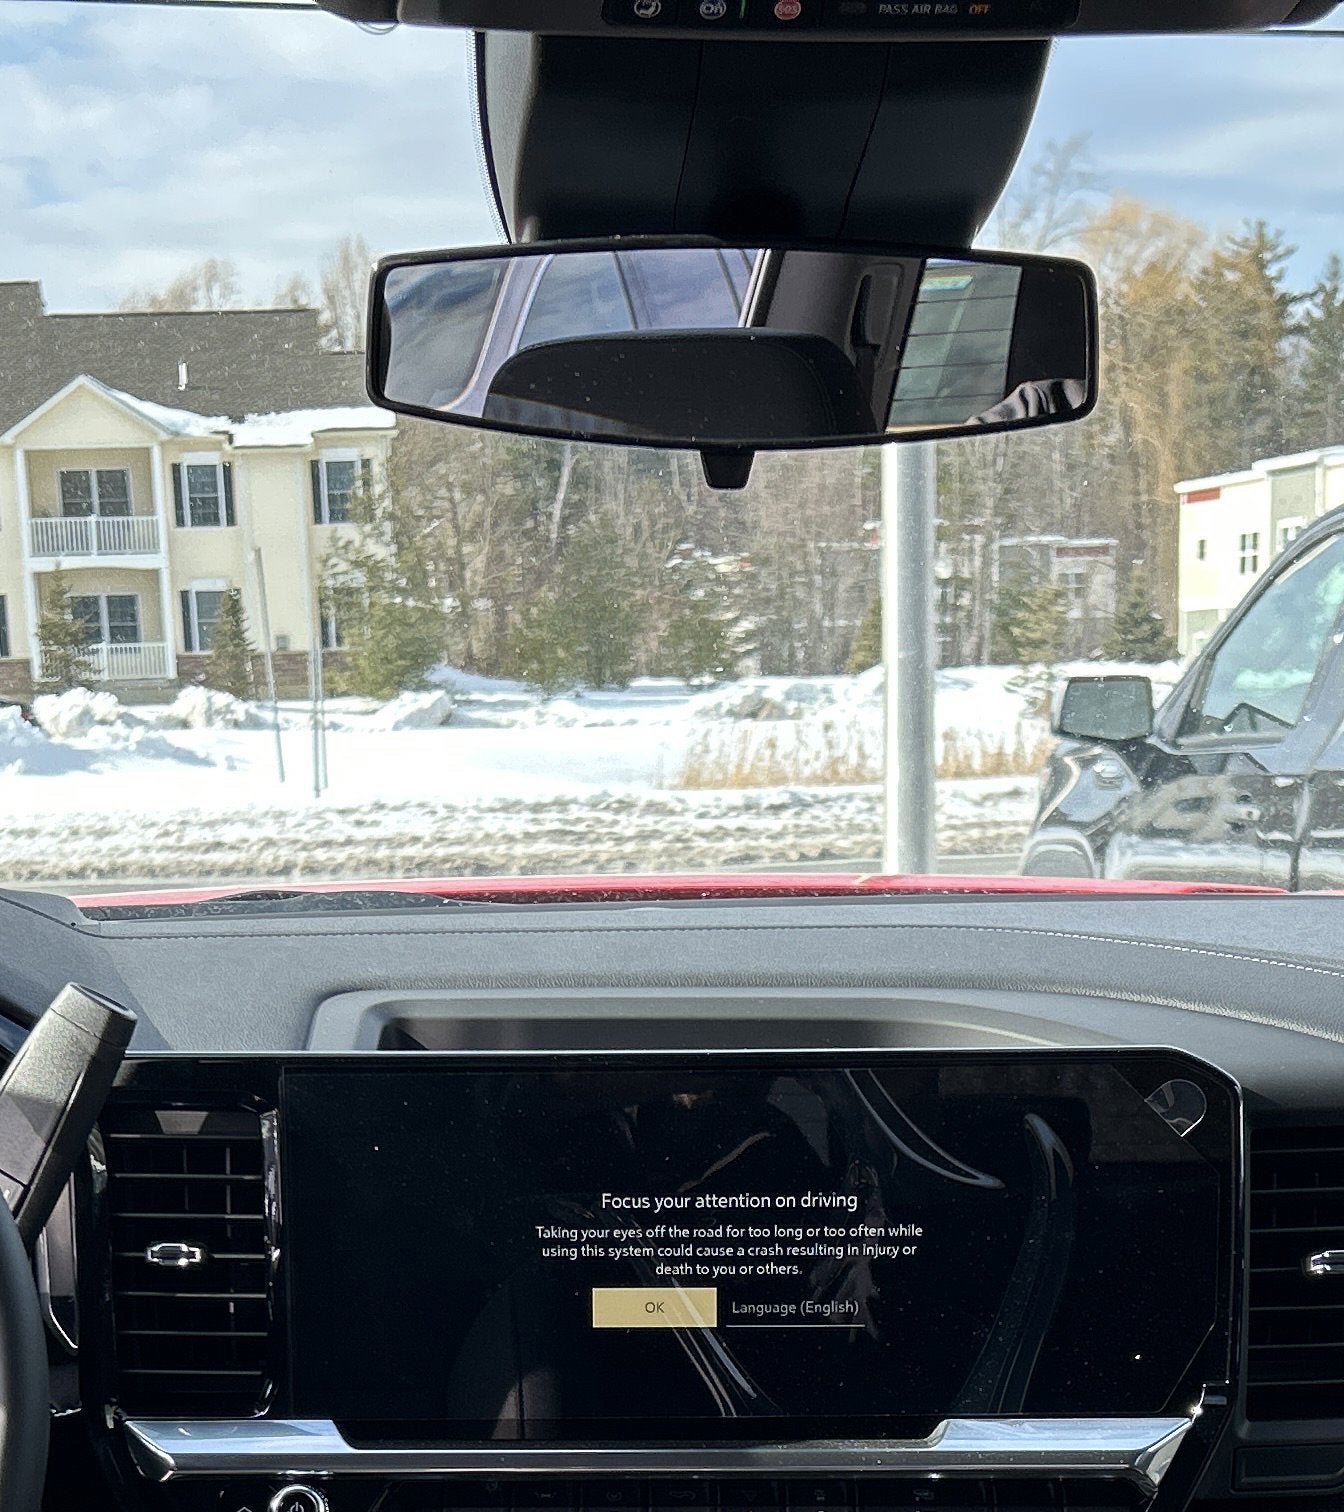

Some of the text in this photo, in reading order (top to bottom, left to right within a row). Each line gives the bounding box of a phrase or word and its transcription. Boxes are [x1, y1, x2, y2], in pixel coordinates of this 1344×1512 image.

[878, 4, 907, 15] PASS
[911, 4, 931, 14] AIR
[934, 4, 957, 14] BAG
[968, 4, 991, 14] OFF
[602, 1191, 858, 1214] Focus your attention on driving
[536, 1224, 923, 1242] Taking your eyes off the road for too long or too often while
[542, 1243, 918, 1260] using this system could cause a crash resulting in injury or
[655, 1262, 803, 1278] death to you or others.
[644, 1302, 666, 1313] OK
[732, 1300, 859, 1317] Language (English)
